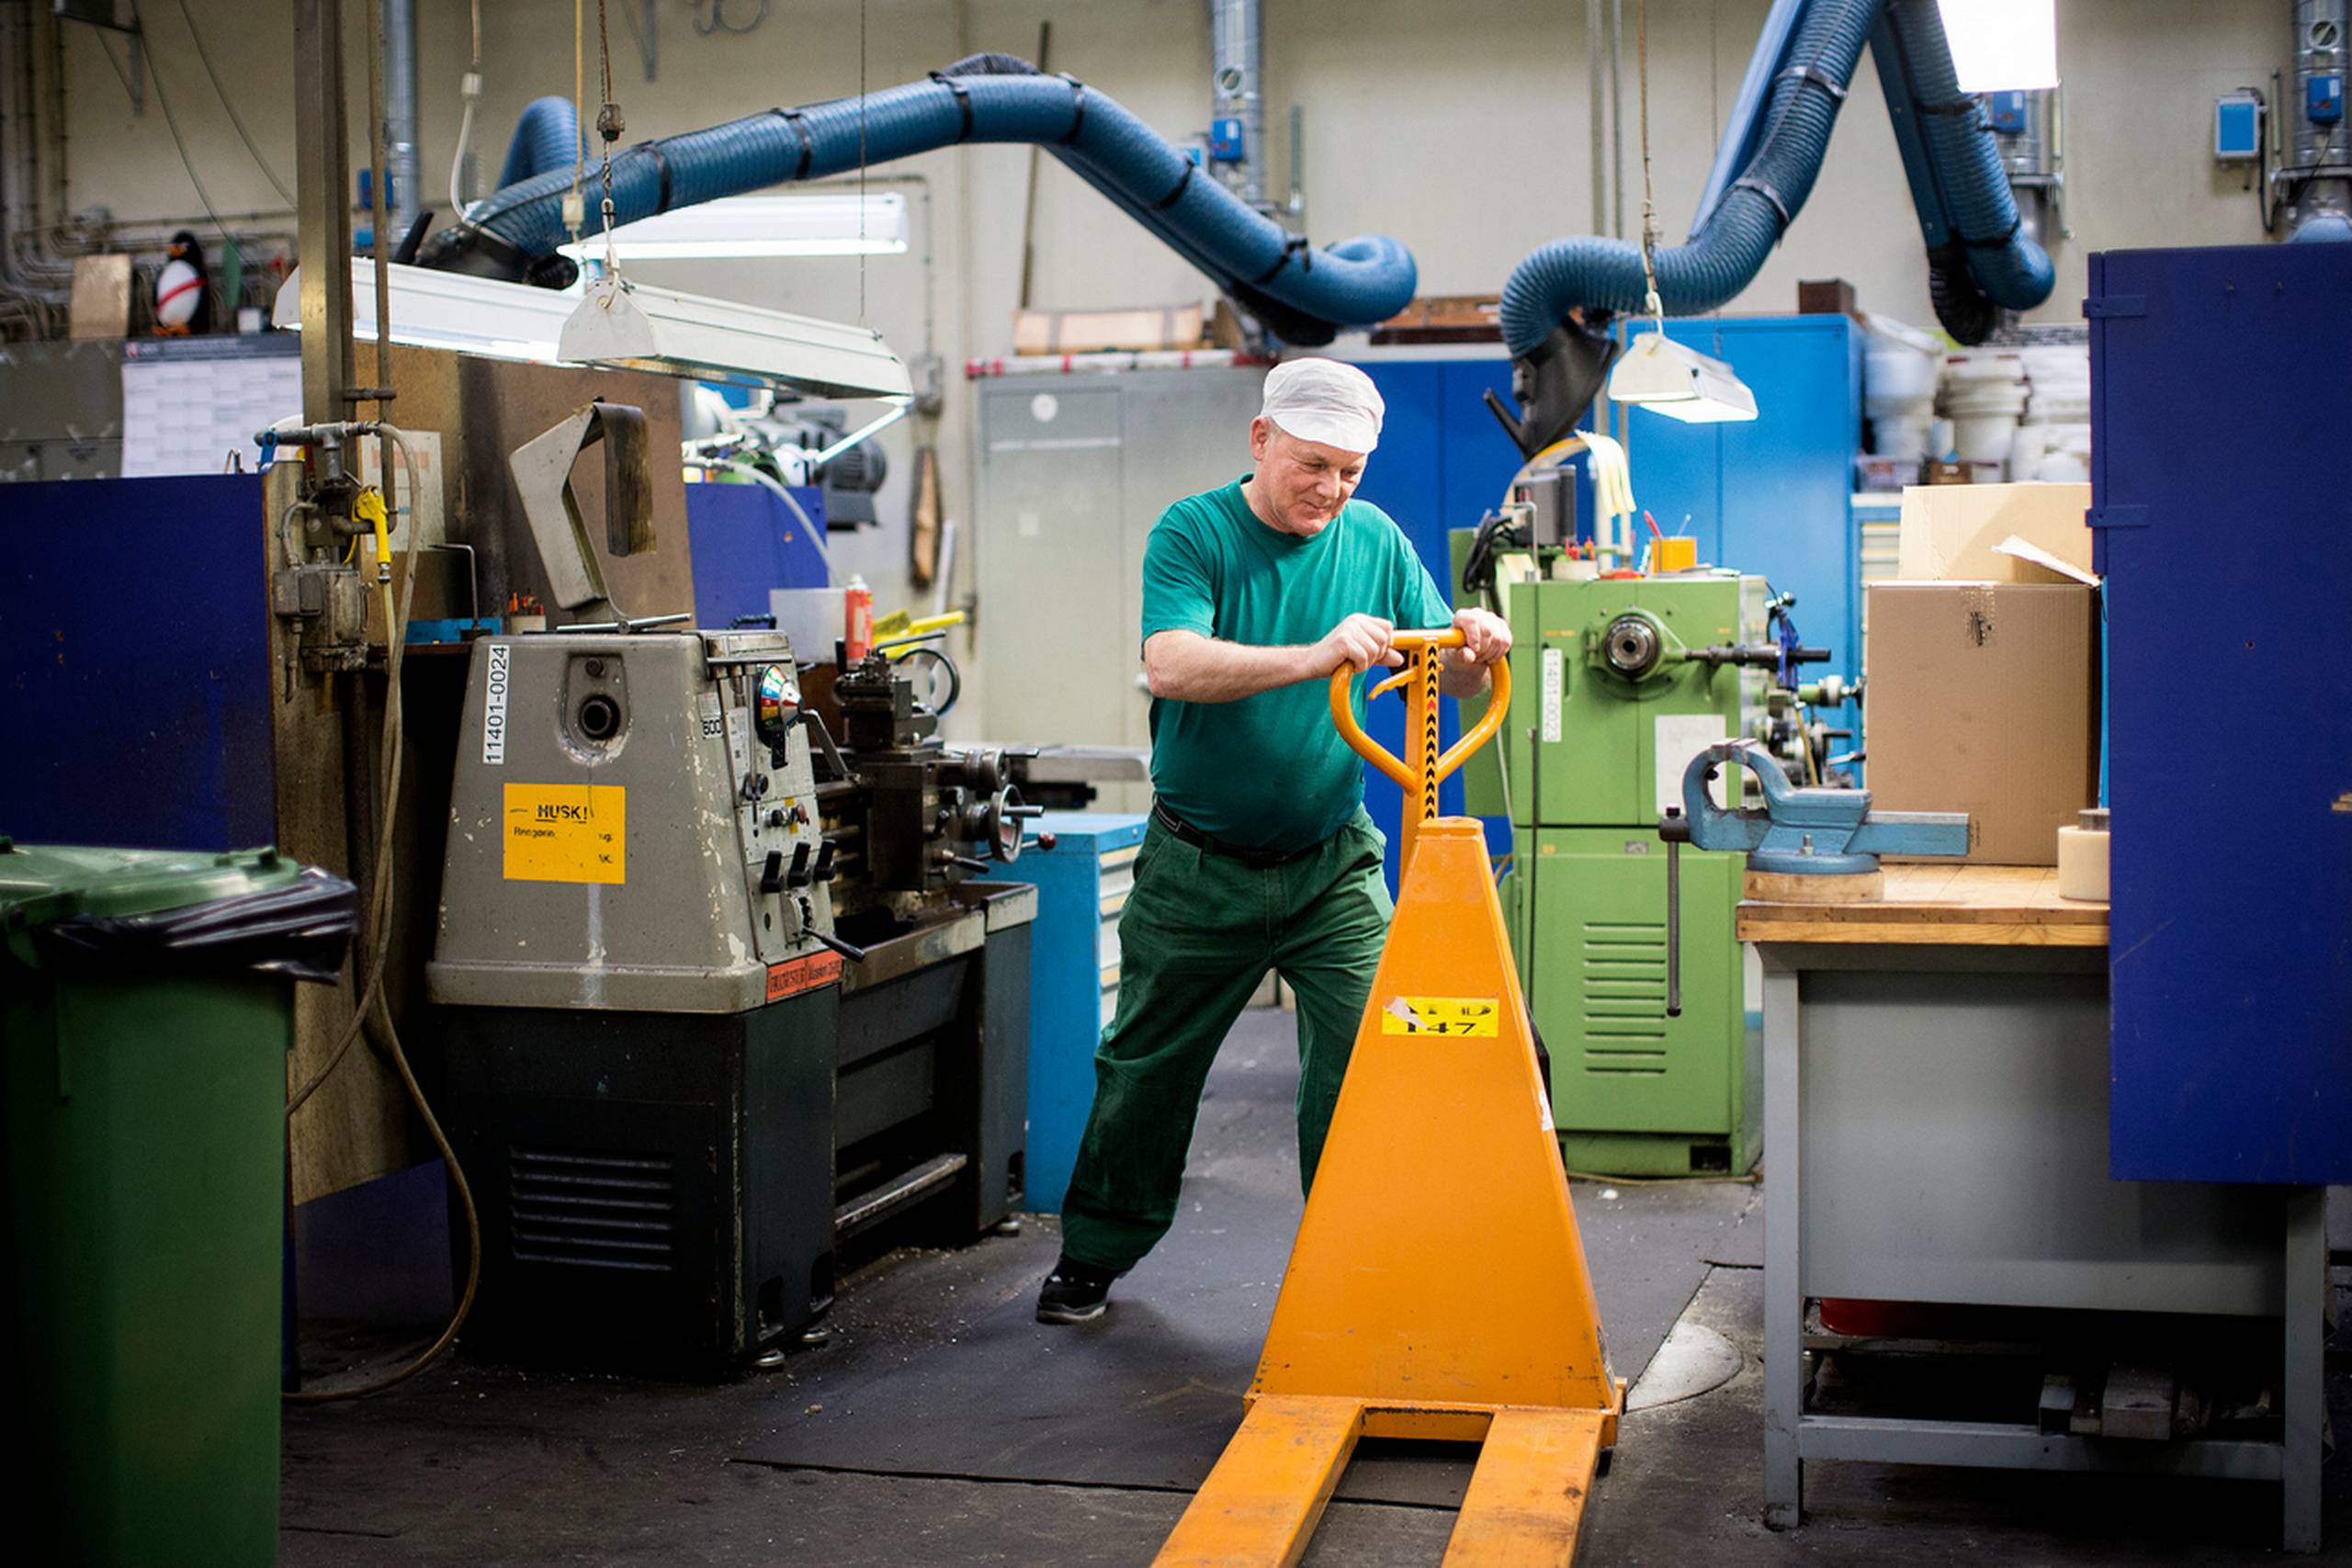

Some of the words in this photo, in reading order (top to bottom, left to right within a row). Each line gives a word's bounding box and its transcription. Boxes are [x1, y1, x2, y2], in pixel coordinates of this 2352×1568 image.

[486, 646, 507, 761] 11401-0024
[537, 804, 588, 820] HUSK!
[1407, 1021, 1476, 1034] 147
